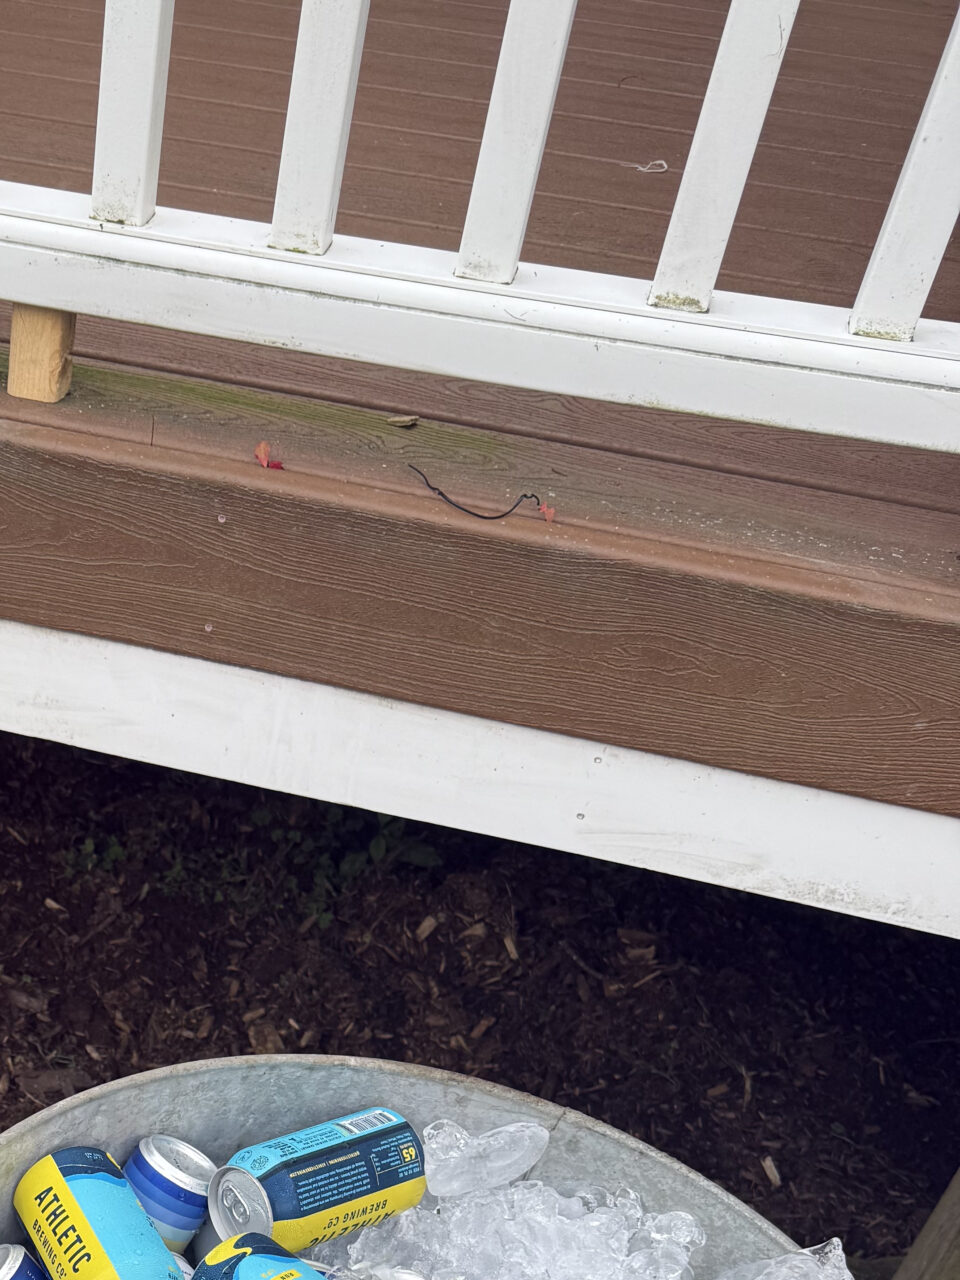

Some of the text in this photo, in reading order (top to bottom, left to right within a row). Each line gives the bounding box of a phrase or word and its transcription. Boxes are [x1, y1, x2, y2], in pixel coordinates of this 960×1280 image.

[403, 1146, 416, 1163] 65
[343, 1199, 388, 1222] BREWING
[32, 1218, 57, 1265] BREWING
[34, 1186, 92, 1274] ATHLETIC
